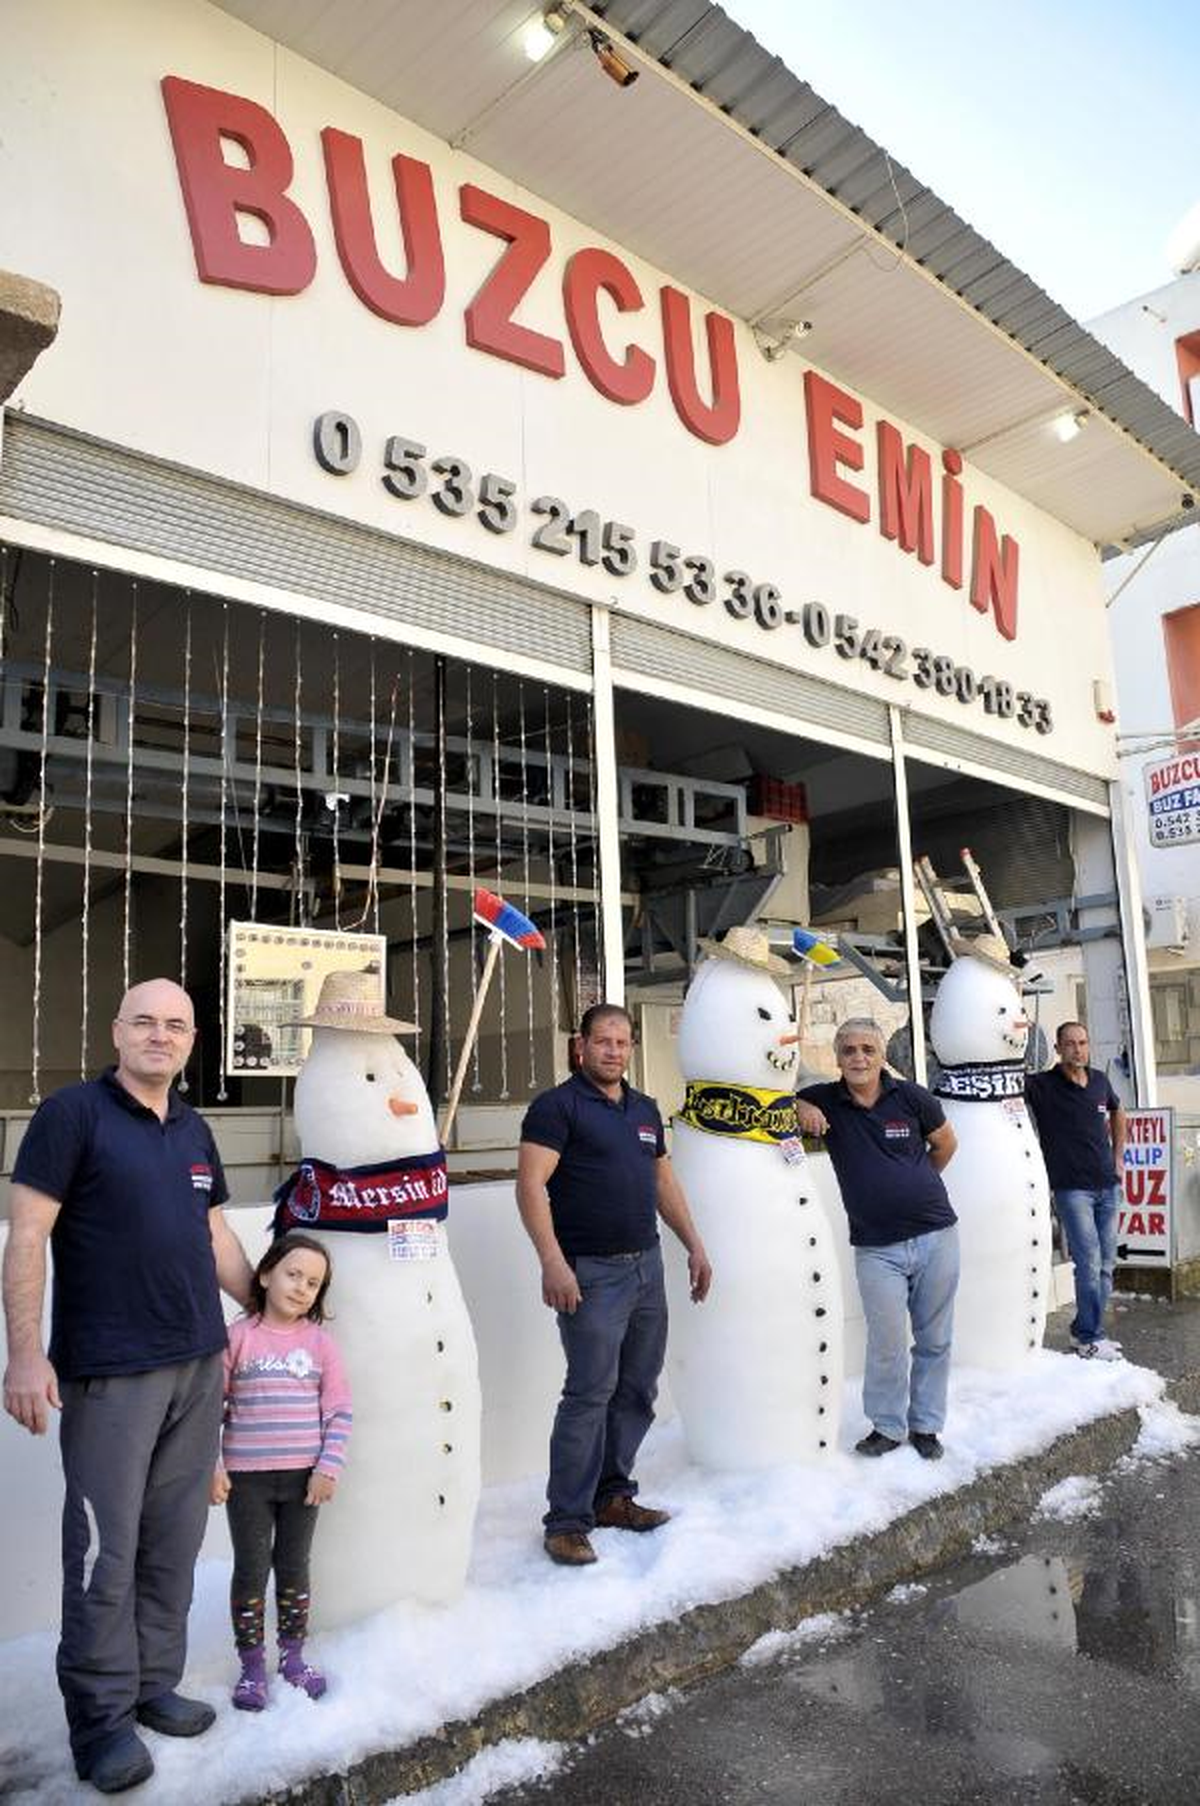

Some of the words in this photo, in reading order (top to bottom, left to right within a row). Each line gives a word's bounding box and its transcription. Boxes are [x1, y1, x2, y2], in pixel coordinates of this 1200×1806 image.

[161, 75, 741, 446] BUZCU
[313, 410, 362, 476] 0
[381, 435, 517, 535] 535
[531, 495, 637, 577] 215
[650, 540, 716, 605] 53
[1016, 691, 1053, 735] 33
[1153, 793, 1182, 813] BUZ
[1126, 1117, 1167, 1144] KTEYL
[1123, 1147, 1163, 1165] ALIP
[328, 1175, 430, 1208] Mersin
[1121, 1170, 1167, 1206] UZ
